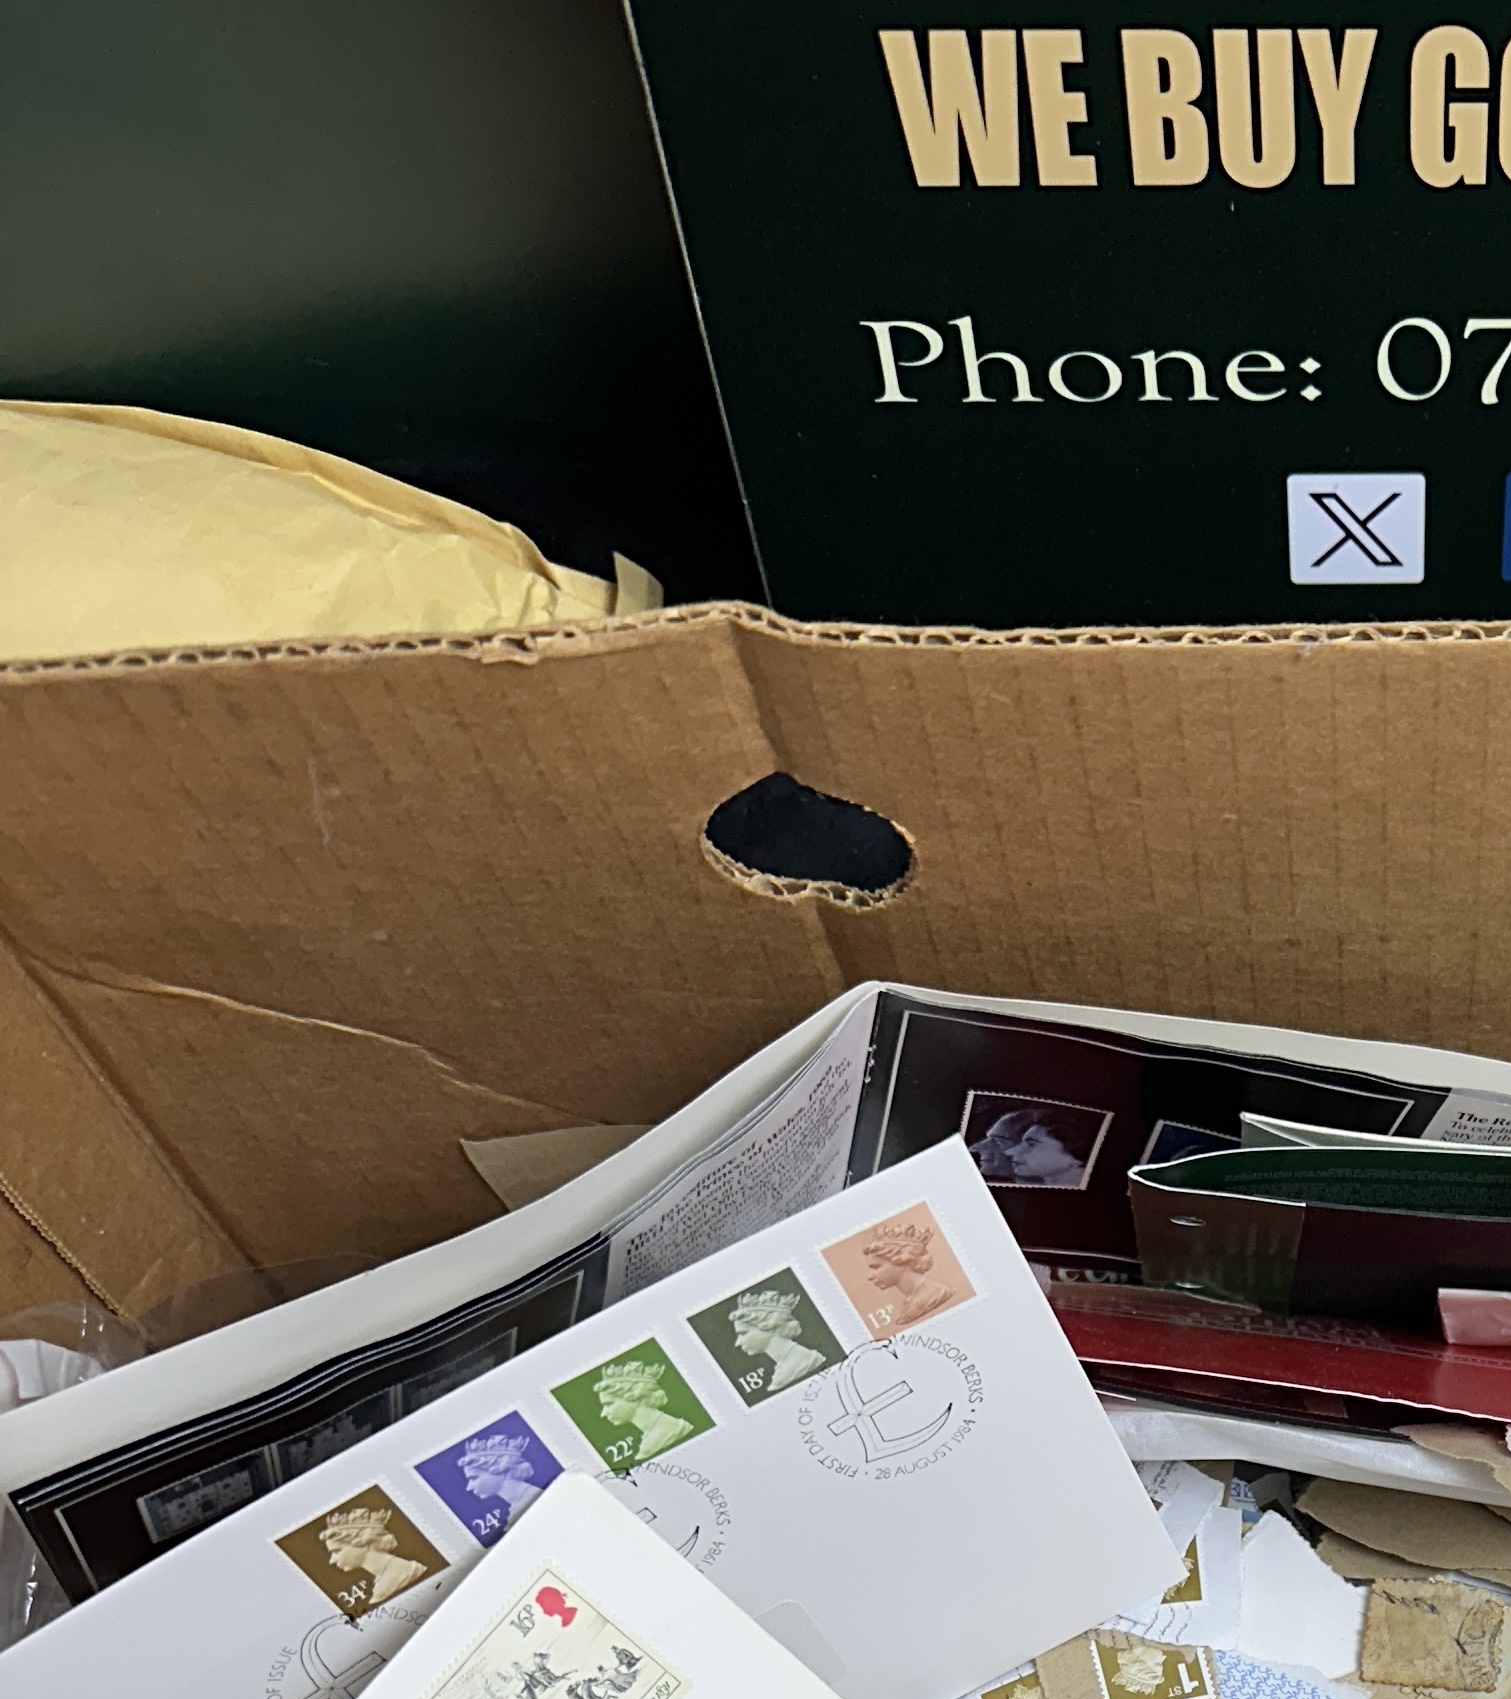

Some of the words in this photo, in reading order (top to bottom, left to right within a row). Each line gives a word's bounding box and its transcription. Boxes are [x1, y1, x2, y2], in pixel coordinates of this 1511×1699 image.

[880, 28, 1097, 187] WE
[1122, 27, 1376, 188] BUY
[860, 316, 1322, 404] Phone:
[894, 1440, 954, 1479] AUGUST
[950, 1418, 977, 1444] 1984
